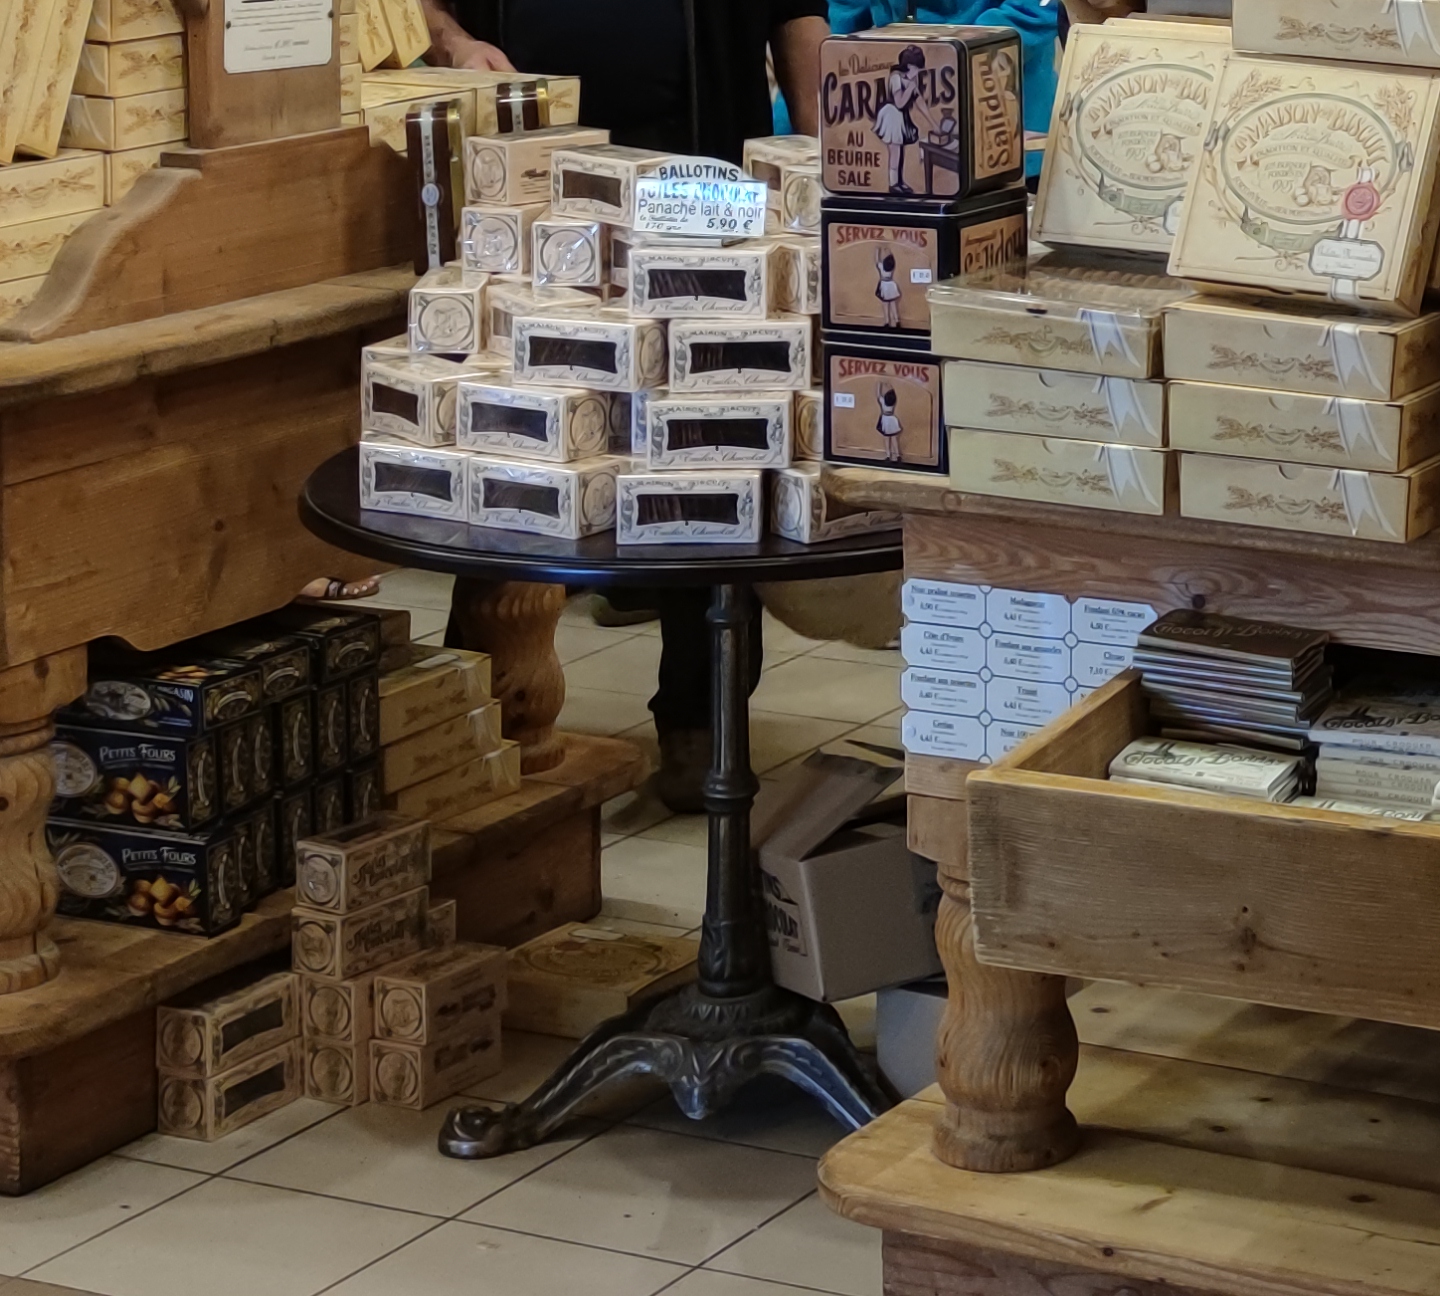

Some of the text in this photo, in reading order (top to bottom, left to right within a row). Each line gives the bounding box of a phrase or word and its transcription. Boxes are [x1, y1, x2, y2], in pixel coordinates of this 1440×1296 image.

[822, 63, 957, 127] CARAELS
[846, 130, 865, 148] AU
[826, 148, 881, 168] BEURRE
[659, 163, 739, 182] BALLOTINS
[638, 198, 764, 218] Panaché lait & noir
[835, 223, 928, 248] SERVEZ VOUS
[837, 358, 929, 383] SERVEZ VOUS
